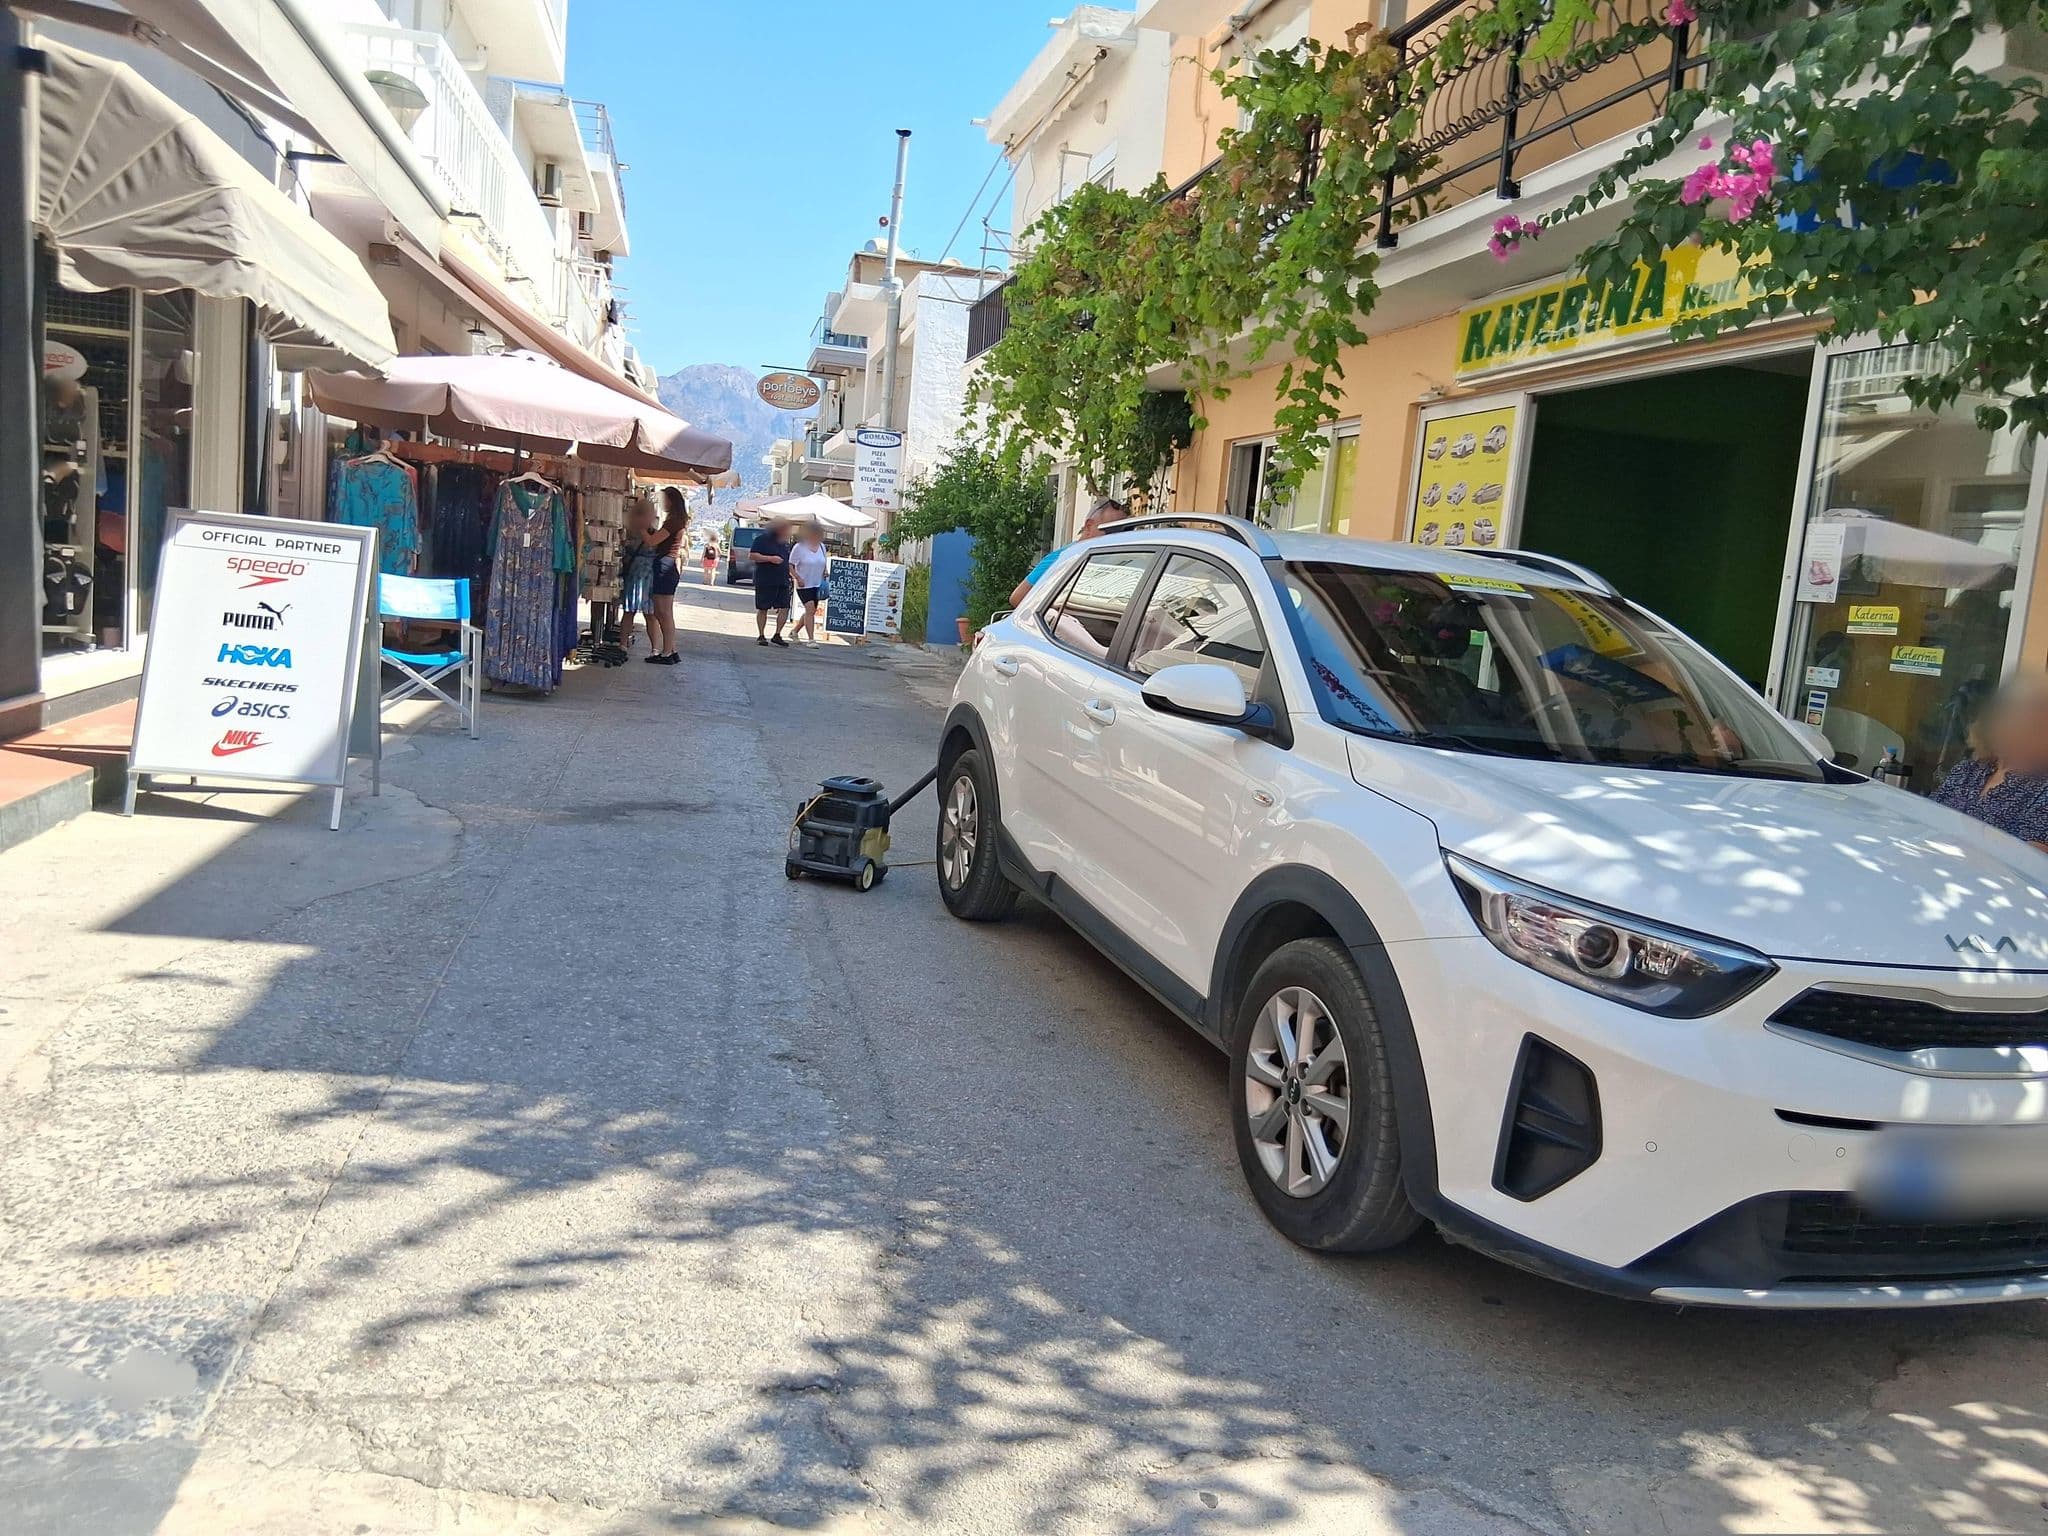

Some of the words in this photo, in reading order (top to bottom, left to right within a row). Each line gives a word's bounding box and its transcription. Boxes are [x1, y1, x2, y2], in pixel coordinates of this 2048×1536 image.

[864, 434, 895, 442] ROMANO
[202, 530, 267, 547] OFFICIAL
[275, 538, 341, 555] PARTNER
[226, 557, 305, 576] speedo
[838, 575, 861, 586] GYROS
[222, 611, 275, 630] PUMA
[1855, 605, 1893, 620] Katerina
[217, 643, 292, 668] HOKA
[1896, 645, 1937, 662] Katerina
[201, 677, 299, 693] SKECHERS
[221, 730, 262, 746] NIKE
